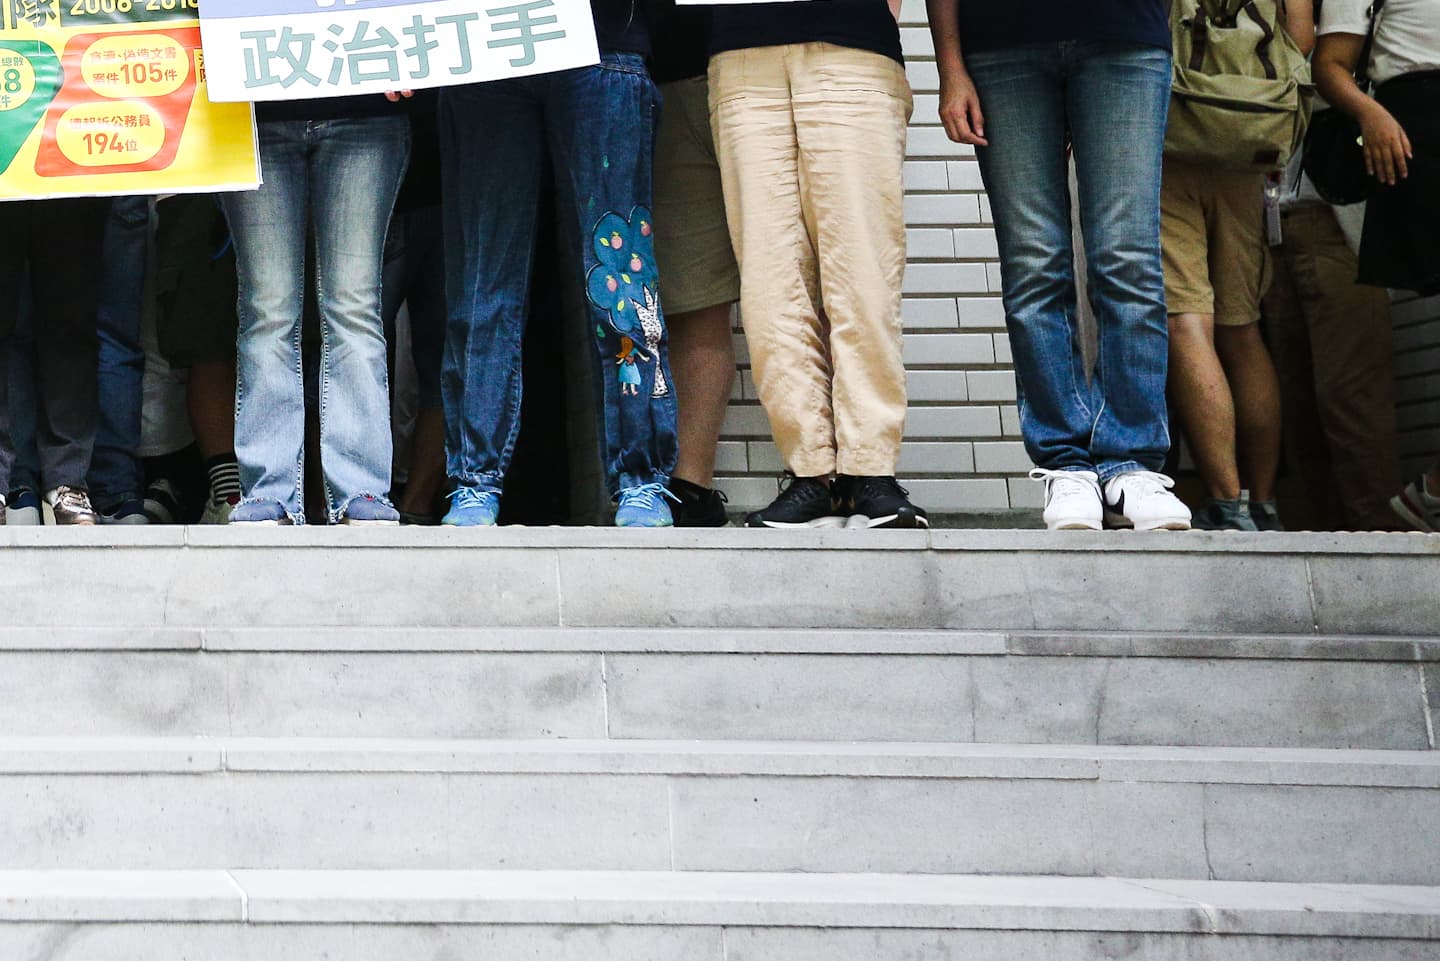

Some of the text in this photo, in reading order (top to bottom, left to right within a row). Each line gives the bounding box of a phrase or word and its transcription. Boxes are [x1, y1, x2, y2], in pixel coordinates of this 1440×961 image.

[240, 0, 566, 90] 政治打手
[82, 132, 138, 155] 194位
